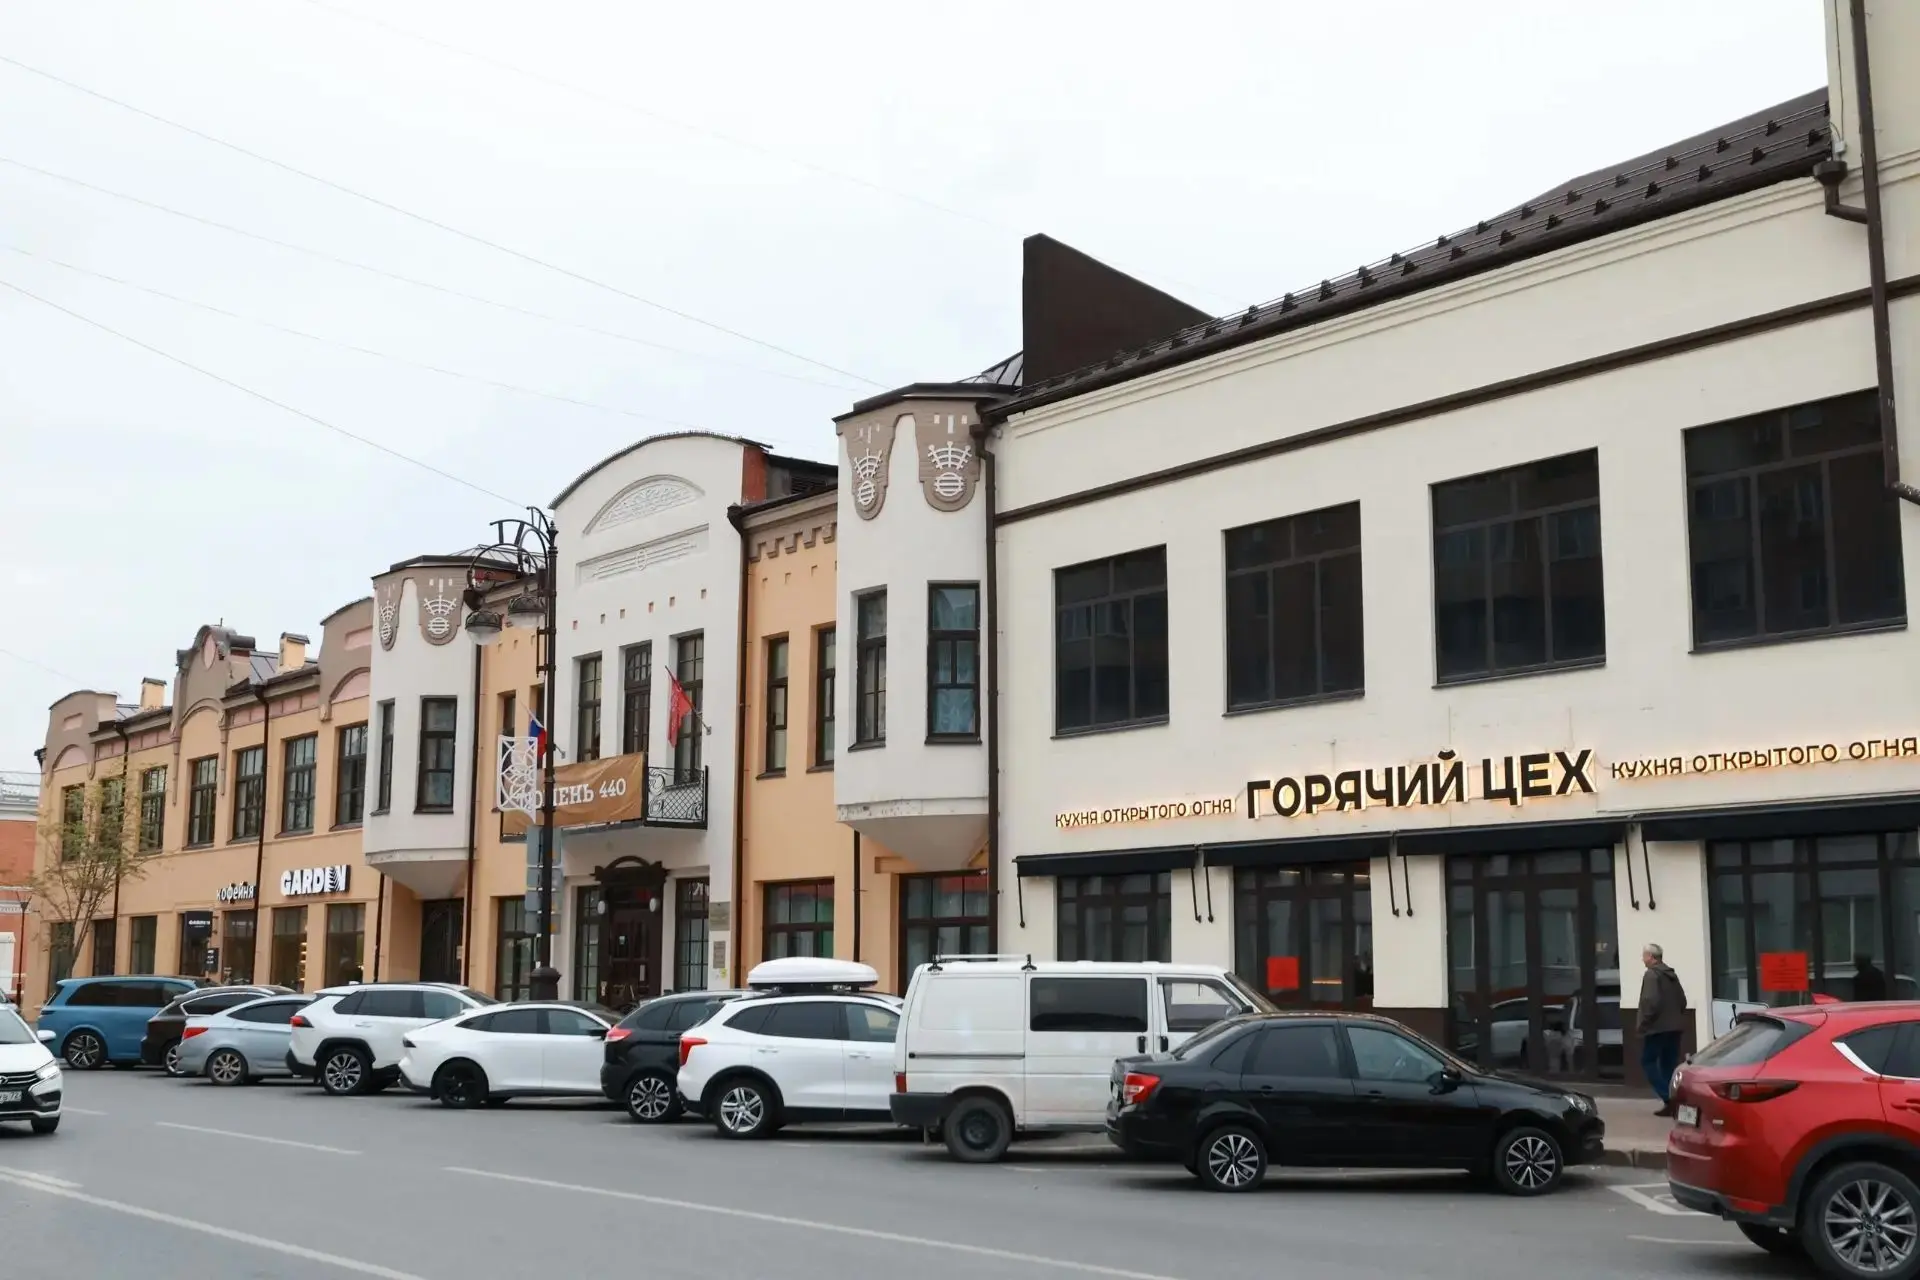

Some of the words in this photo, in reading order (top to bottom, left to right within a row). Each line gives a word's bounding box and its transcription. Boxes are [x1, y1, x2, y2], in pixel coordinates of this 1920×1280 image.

[1611, 757, 1683, 779] КУХНЯ
[1692, 744, 1838, 773] ОТКРЫТОГО
[1849, 737, 1918, 760] ОГНЯ
[599, 778, 626, 799] 440
[1247, 750, 1465, 819] ГОРЯЧИЙ
[1482, 750, 1596, 806] ЦЕХ
[1055, 811, 1098, 828] КУХНЯ
[1103, 802, 1187, 822] ОТКРЫТОГО
[1192, 799, 1233, 816] ОГНЯ
[280, 864, 347, 897] GARDEN
